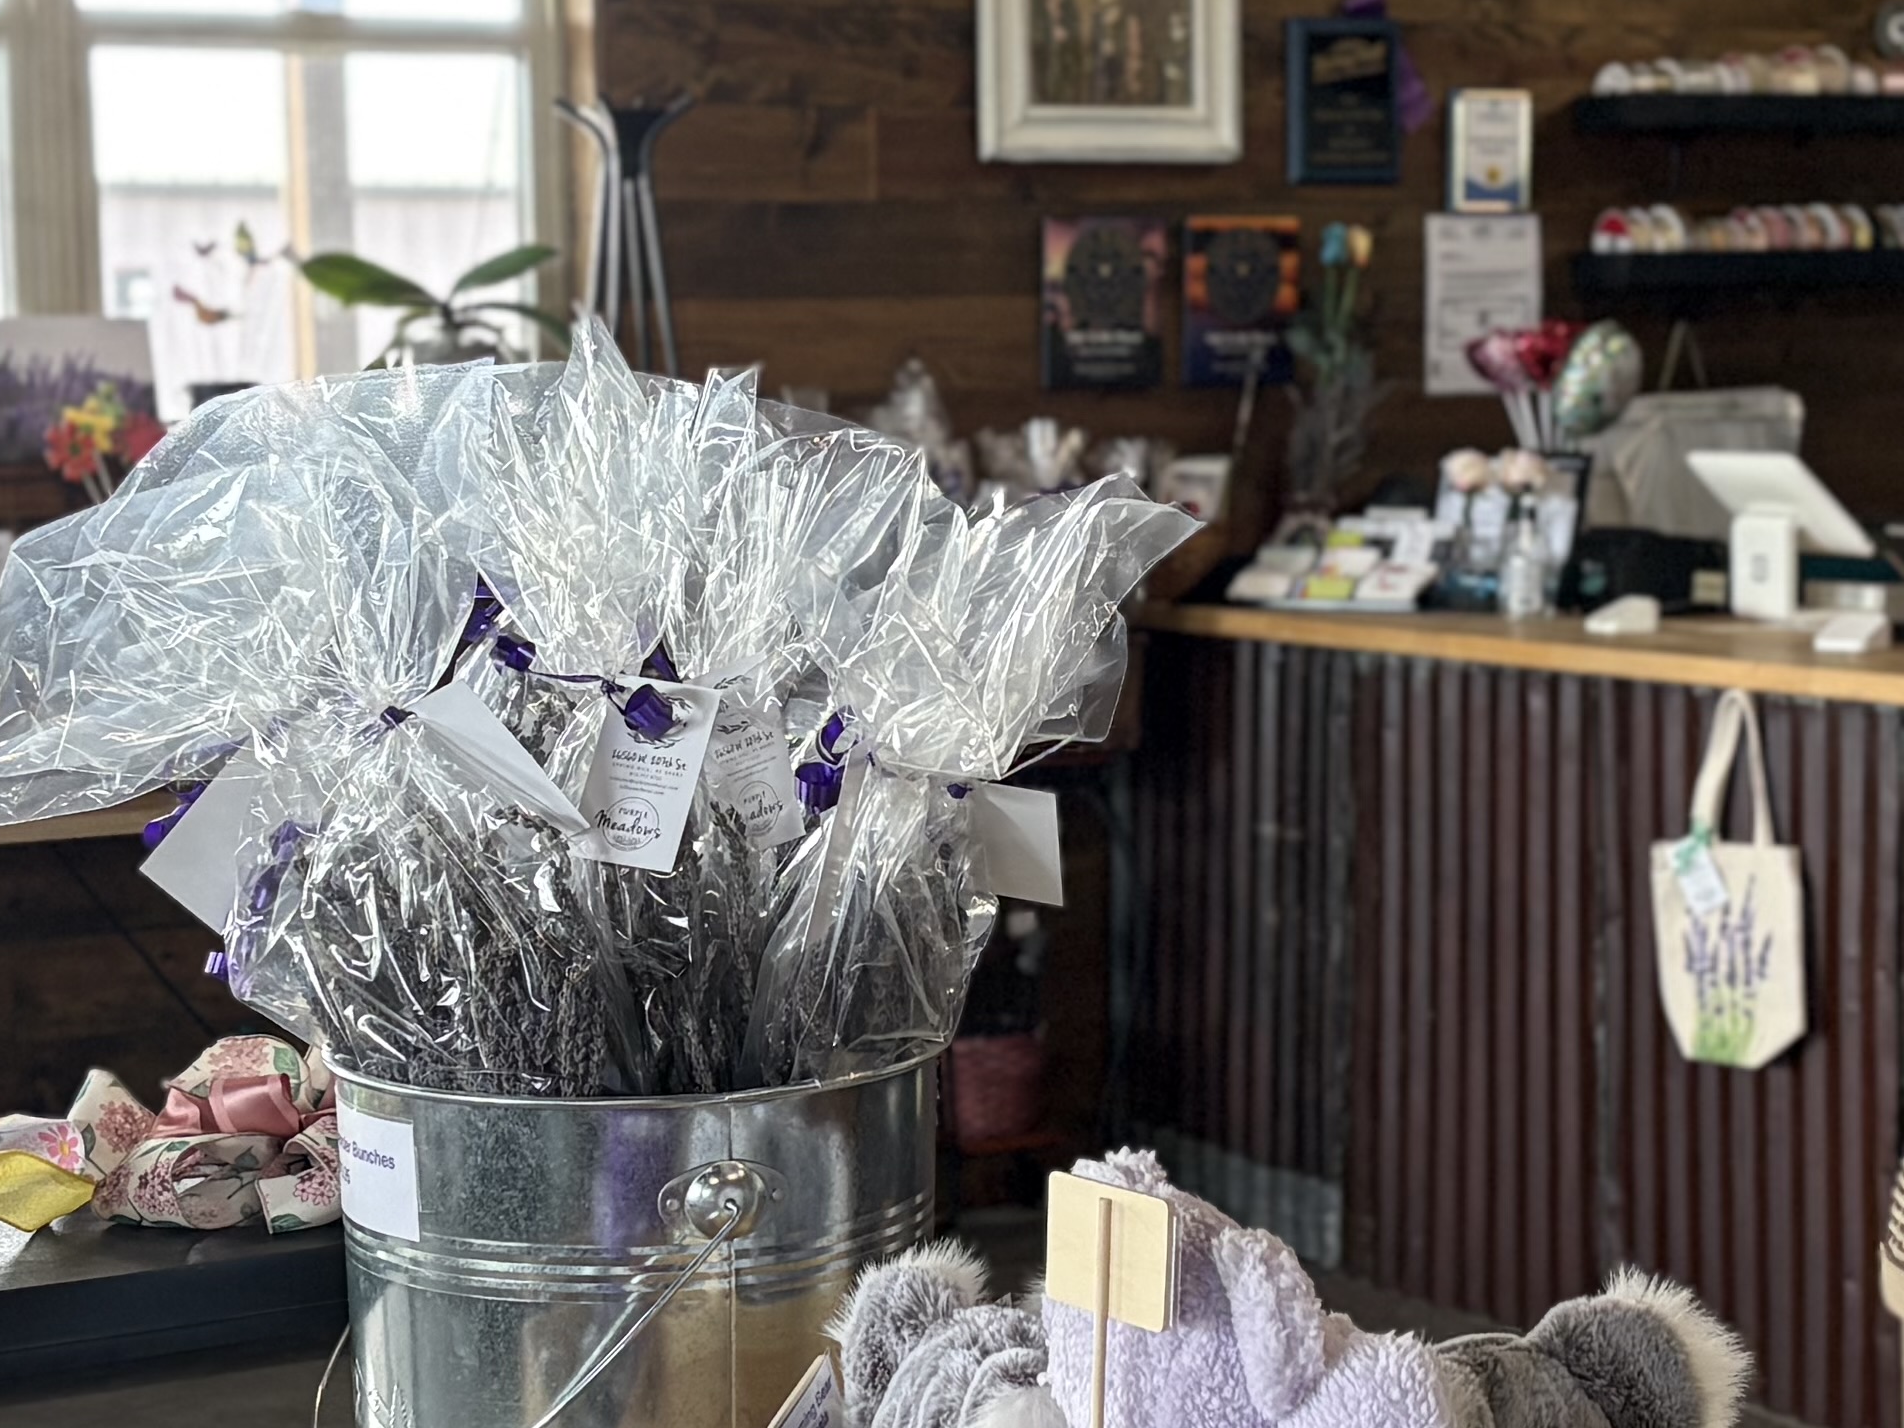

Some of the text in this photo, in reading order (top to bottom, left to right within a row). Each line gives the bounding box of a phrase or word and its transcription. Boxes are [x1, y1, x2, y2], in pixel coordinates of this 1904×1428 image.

[595, 809, 662, 839] Meadows
[749, 797, 784, 821] adows
[352, 1140, 396, 1170] Bunches
